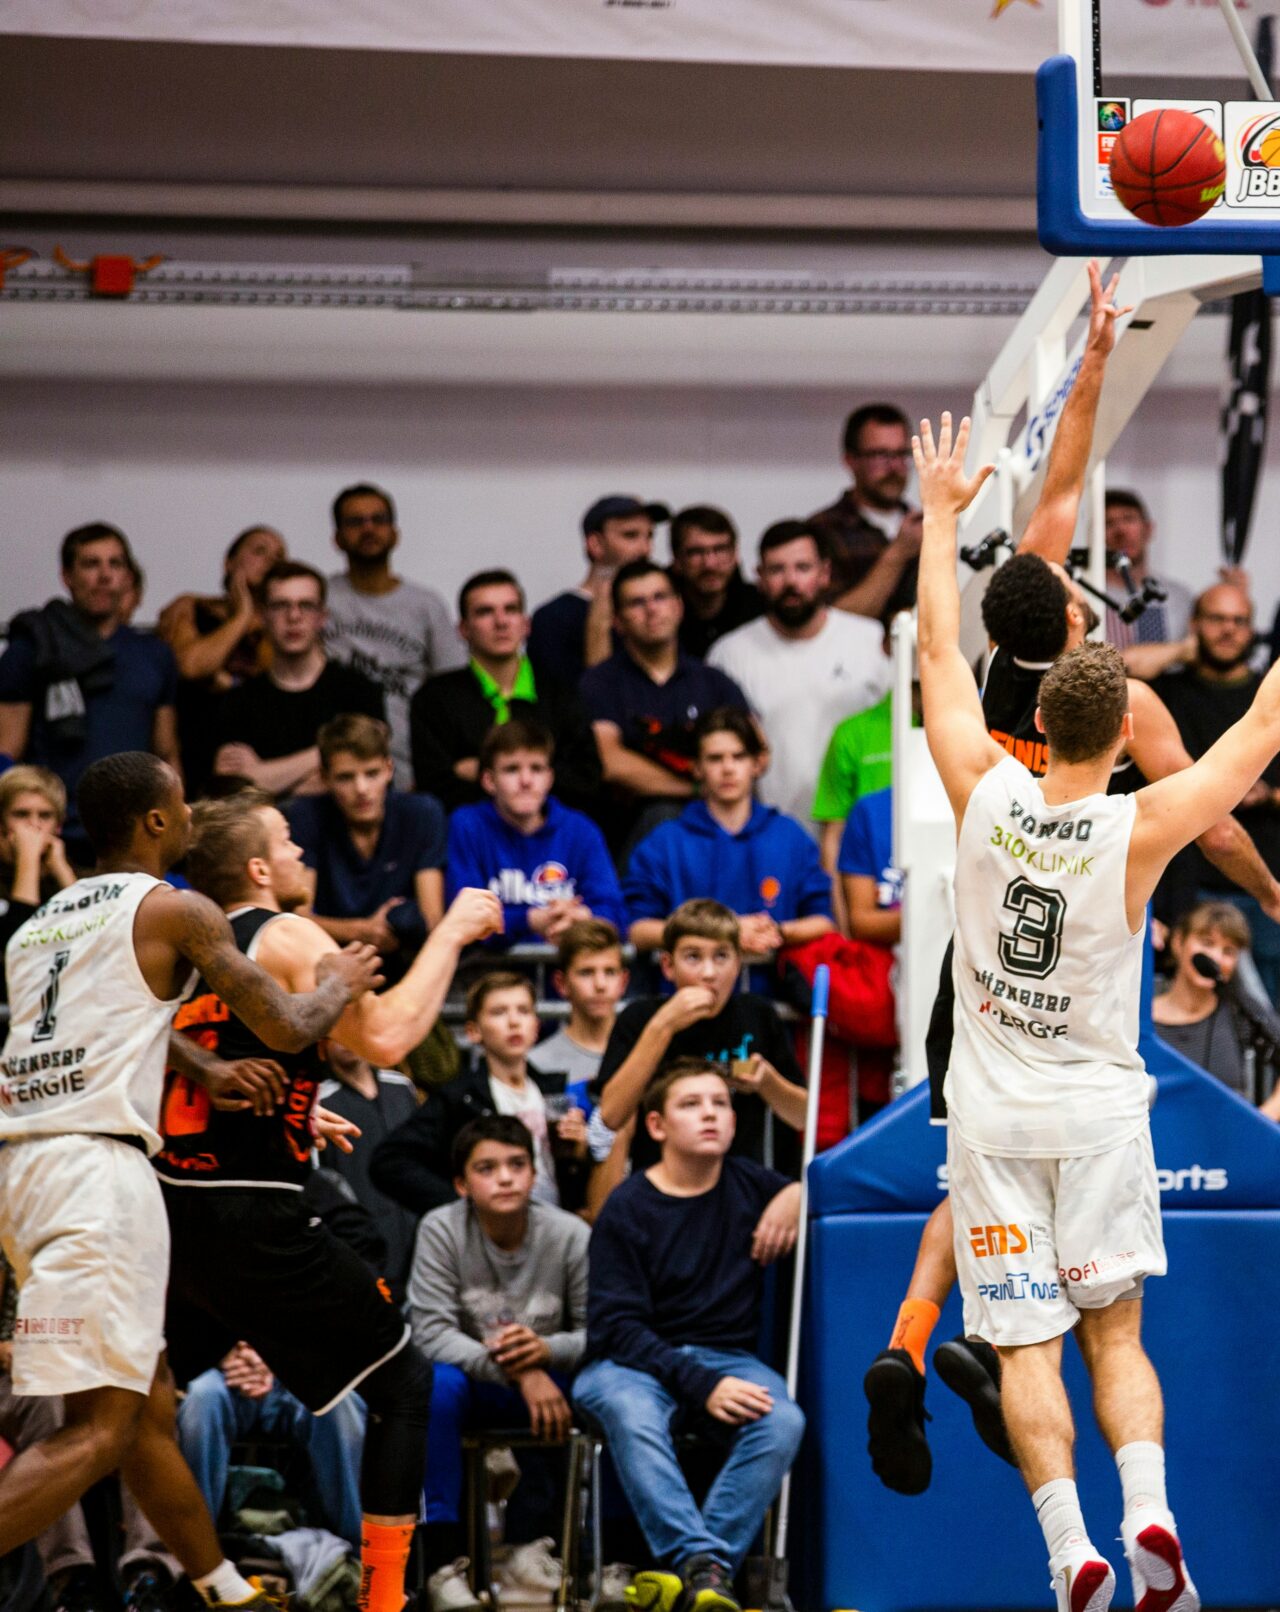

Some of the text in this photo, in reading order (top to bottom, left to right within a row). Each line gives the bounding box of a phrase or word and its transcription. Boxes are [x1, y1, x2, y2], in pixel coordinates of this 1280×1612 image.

[997, 875, 1068, 980] 3
[31, 950, 70, 1043] 1
[1157, 1164, 1229, 1191] orts
